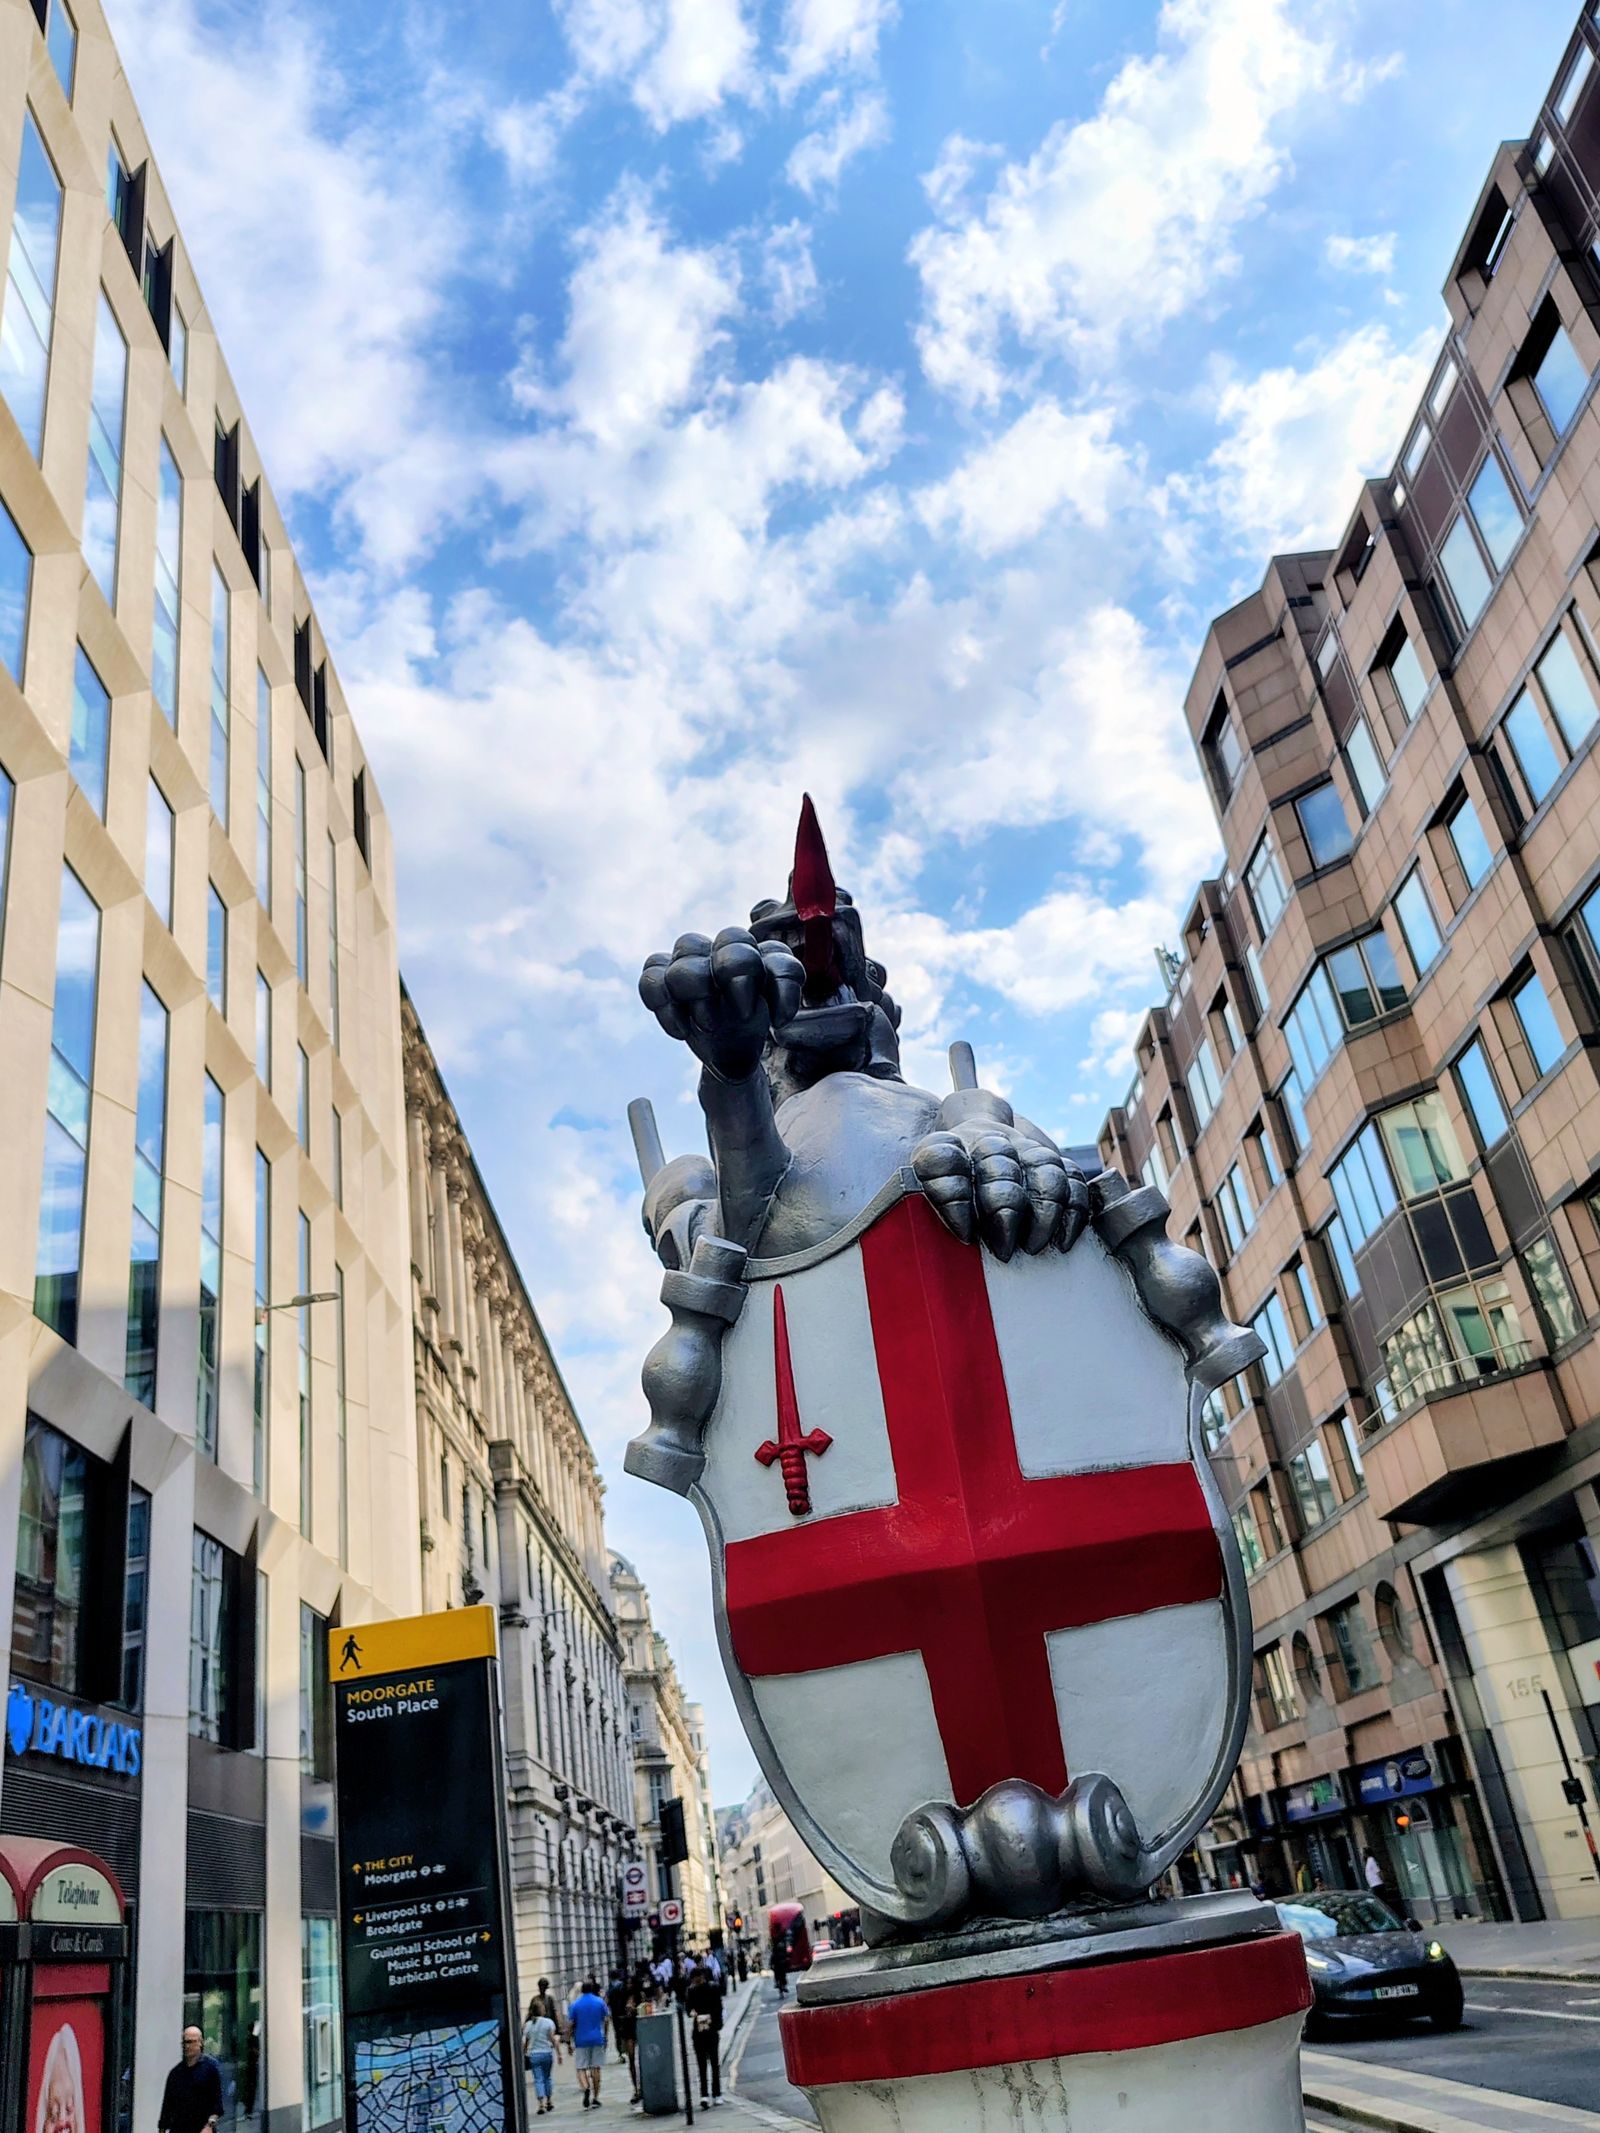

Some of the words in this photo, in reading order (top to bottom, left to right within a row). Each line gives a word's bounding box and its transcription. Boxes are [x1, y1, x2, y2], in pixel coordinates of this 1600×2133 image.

[347, 1679, 435, 1705] MOORGATE
[1506, 1674, 1543, 1699] 155
[347, 1703, 393, 1722] South
[397, 1698, 439, 1715] Place
[38, 1698, 141, 1776] BARCLAYS
[365, 1859, 385, 1871] THE
[388, 1855, 414, 1868] CITY
[365, 1869, 417, 1886] Moorgate
[58, 1880, 100, 1909] Telephone
[365, 1904, 418, 1922] Liverpool
[420, 1902, 432, 1914] St
[366, 1920, 423, 1937] Broadgate
[370, 1942, 421, 1959] Guildhall
[423, 1936, 462, 1952] School
[464, 1932, 477, 1944] of
[387, 1958, 420, 1971] Music
[423, 1955, 432, 1966] &
[434, 1950, 471, 1964] Drama
[388, 1970, 437, 1986] Barbican
[440, 1963, 479, 1977] Centre
